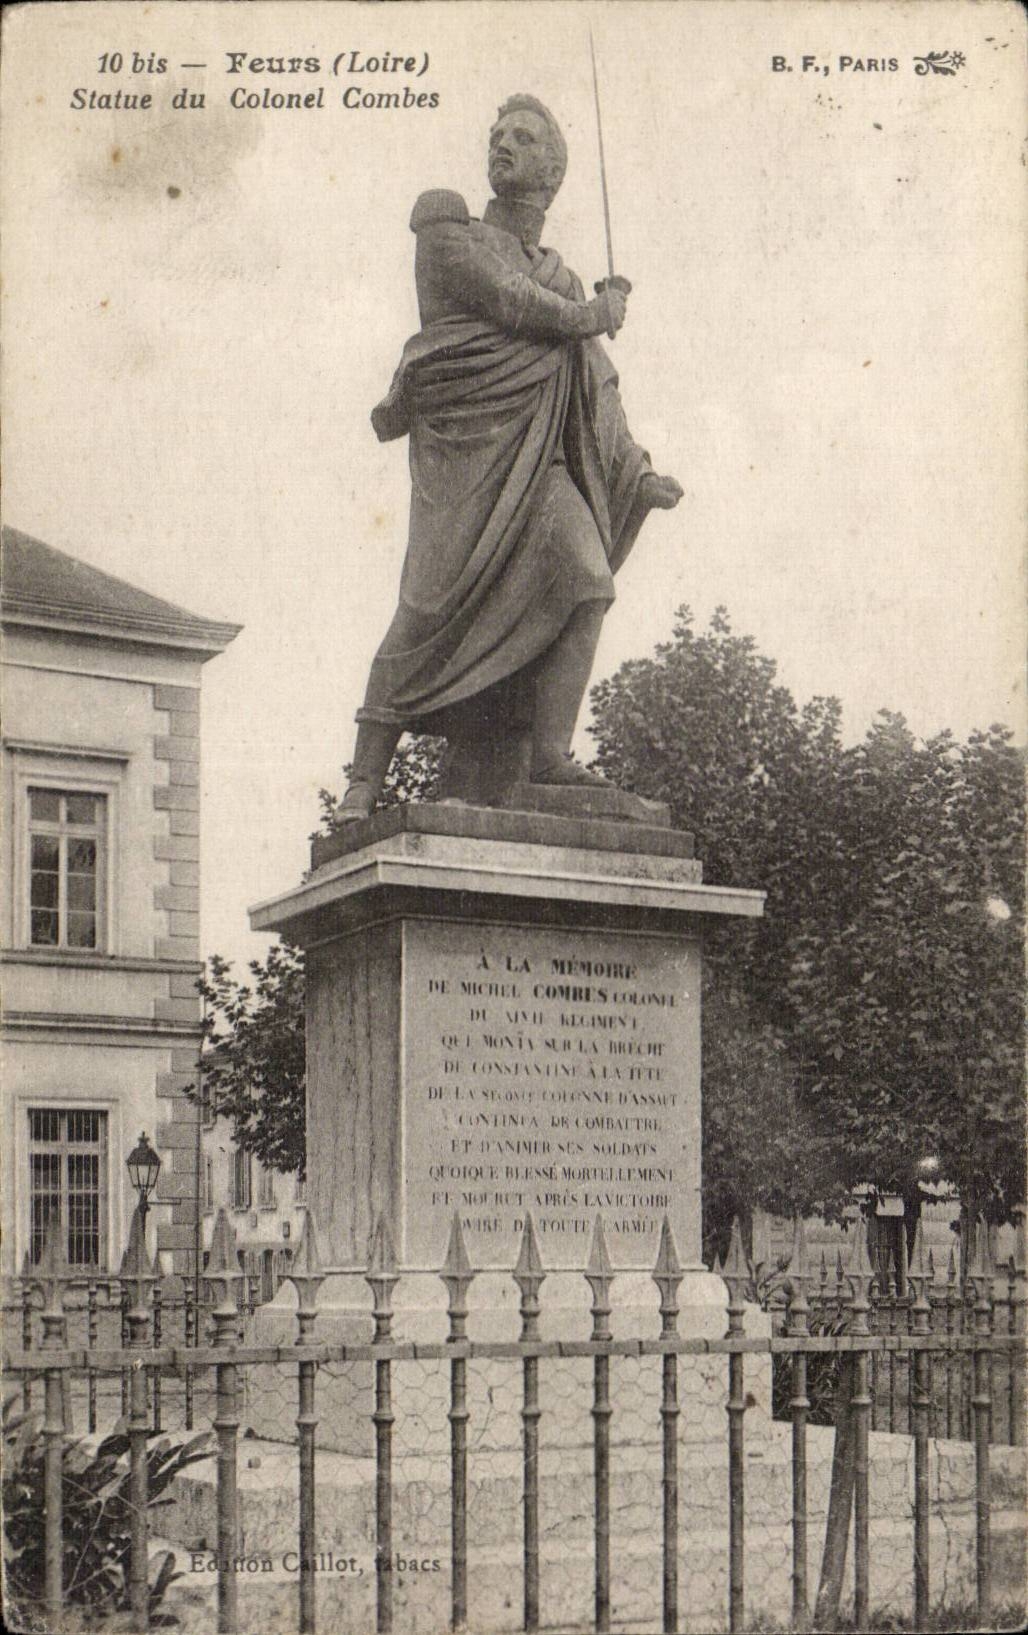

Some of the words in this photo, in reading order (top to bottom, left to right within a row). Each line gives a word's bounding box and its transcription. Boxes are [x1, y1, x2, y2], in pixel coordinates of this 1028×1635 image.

[506, 956, 531, 974] LA
[428, 979, 449, 995] DE
[461, 981, 521, 999] MICHEL
[533, 983, 608, 1004] COMBES
[613, 992, 679, 1008] COLONEL
[470, 1008, 487, 1022] DU
[441, 1034, 470, 1050] QUI
[544, 1037, 571, 1053] SUR
[579, 1040, 599, 1054] LA
[443, 1060, 461, 1074] DE
[428, 1086, 446, 1100] DE
[455, 1086, 475, 1100] LA
[551, 1115, 570, 1129] DE
[451, 1140, 472, 1153] ET
[557, 1141, 584, 1155] SES
[592, 1143, 657, 1156] SOLDATS
[429, 1165, 499, 1182] QUOIQUE
[562, 1167, 675, 1182] MORTELLEMENT
[432, 1192, 452, 1206] ET
[461, 1192, 525, 1207] MOURUT
[584, 1194, 602, 1207] LA
[603, 1194, 672, 1208] VICTOIRE
[540, 1219, 590, 1233] TOUTE
